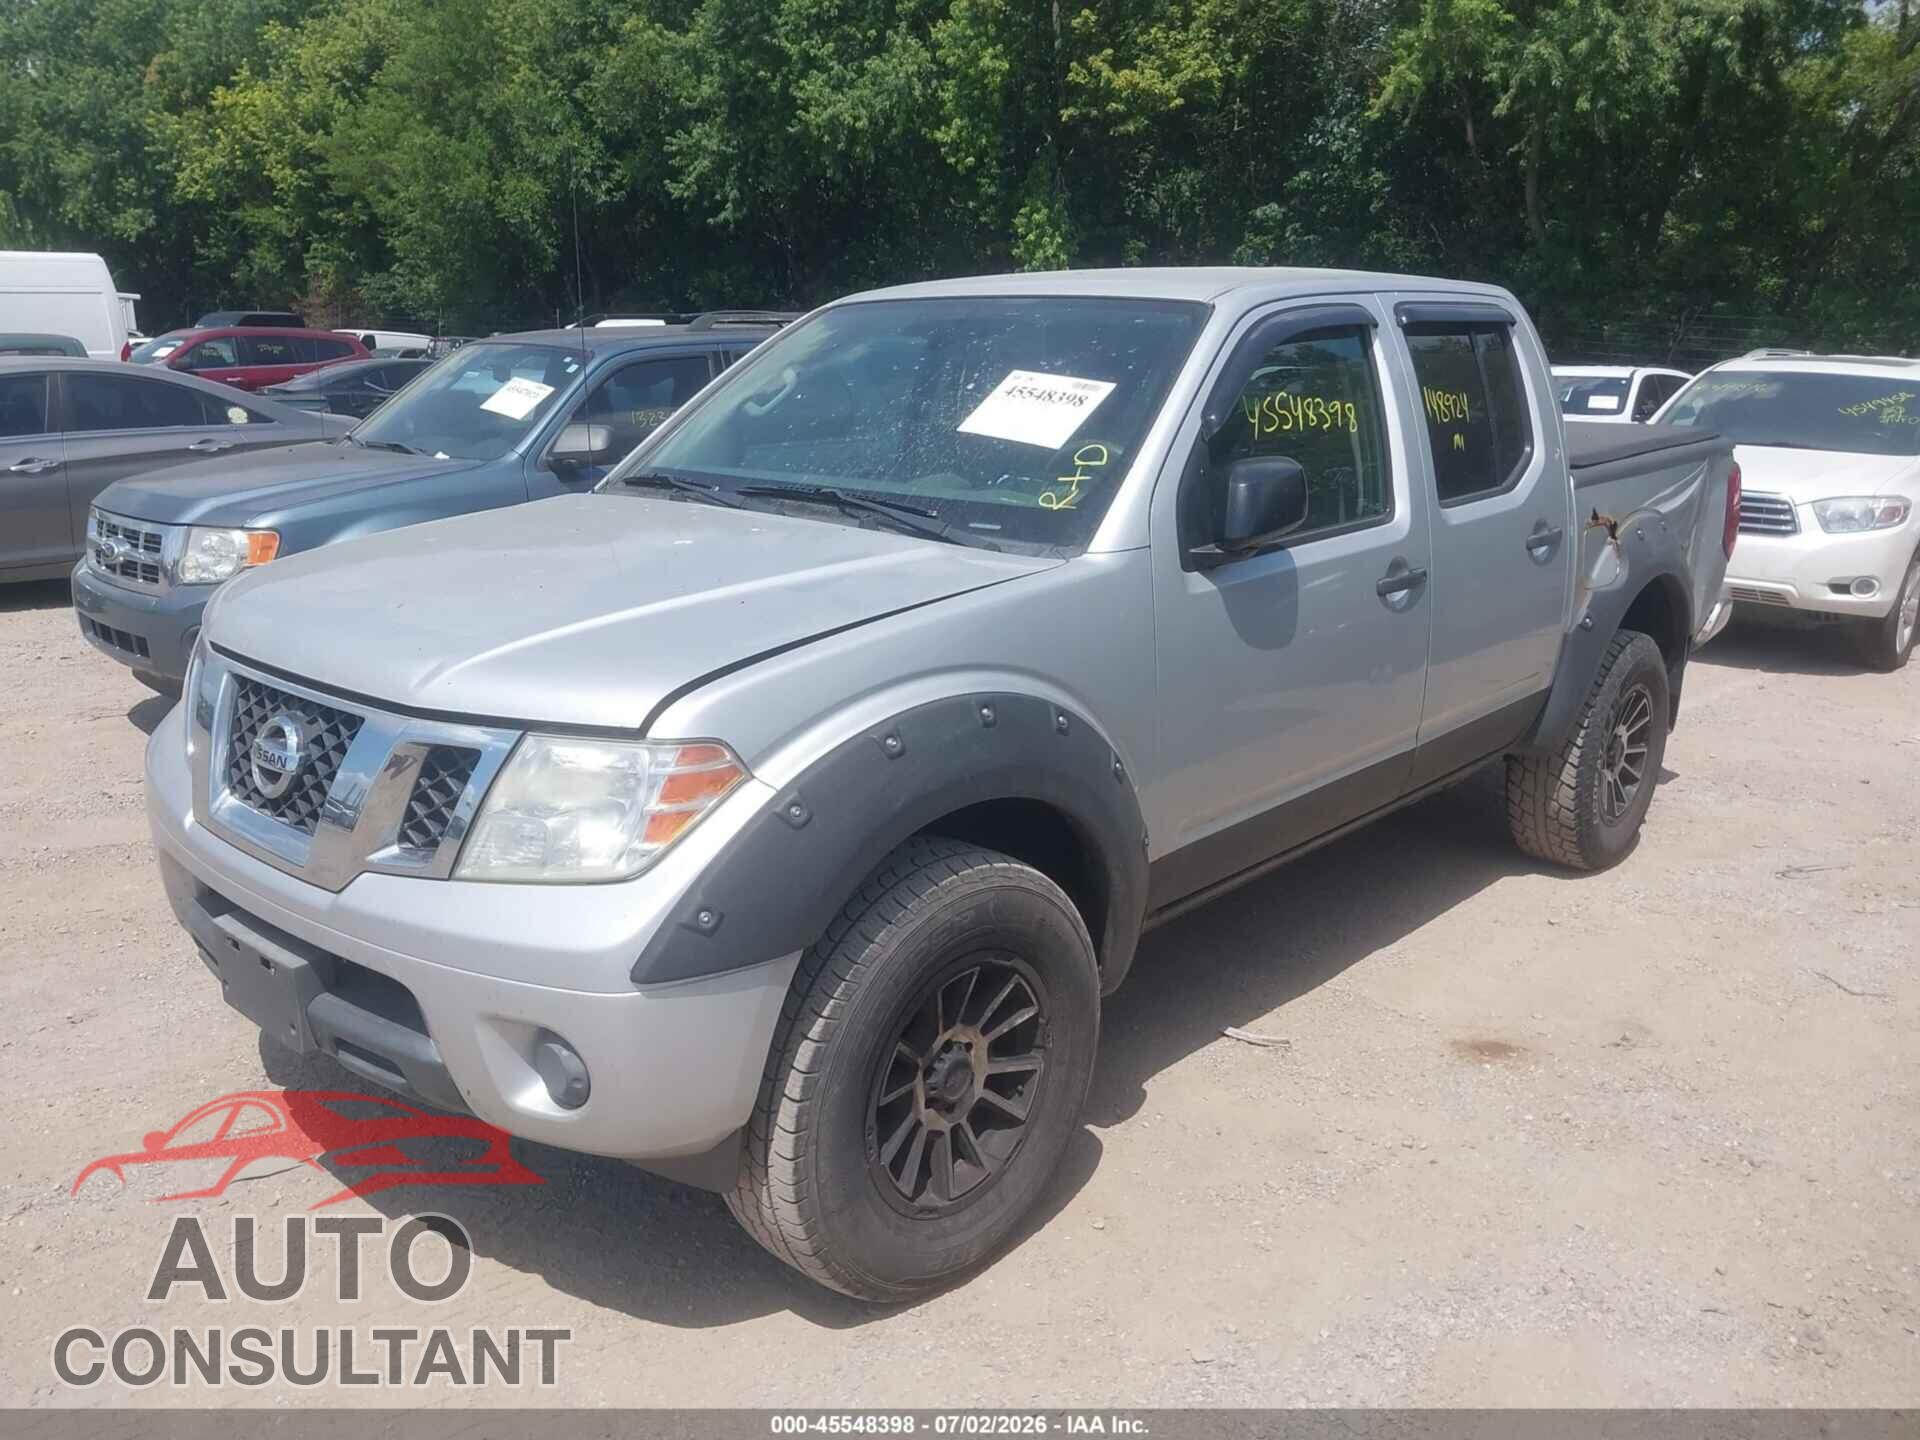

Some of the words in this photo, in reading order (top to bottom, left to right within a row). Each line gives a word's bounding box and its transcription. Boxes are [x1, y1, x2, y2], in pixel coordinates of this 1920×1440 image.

[1006, 384, 1089, 408] 45548398
[1242, 391, 1358, 440] 45548398
[254, 747, 288, 769] SSAN
